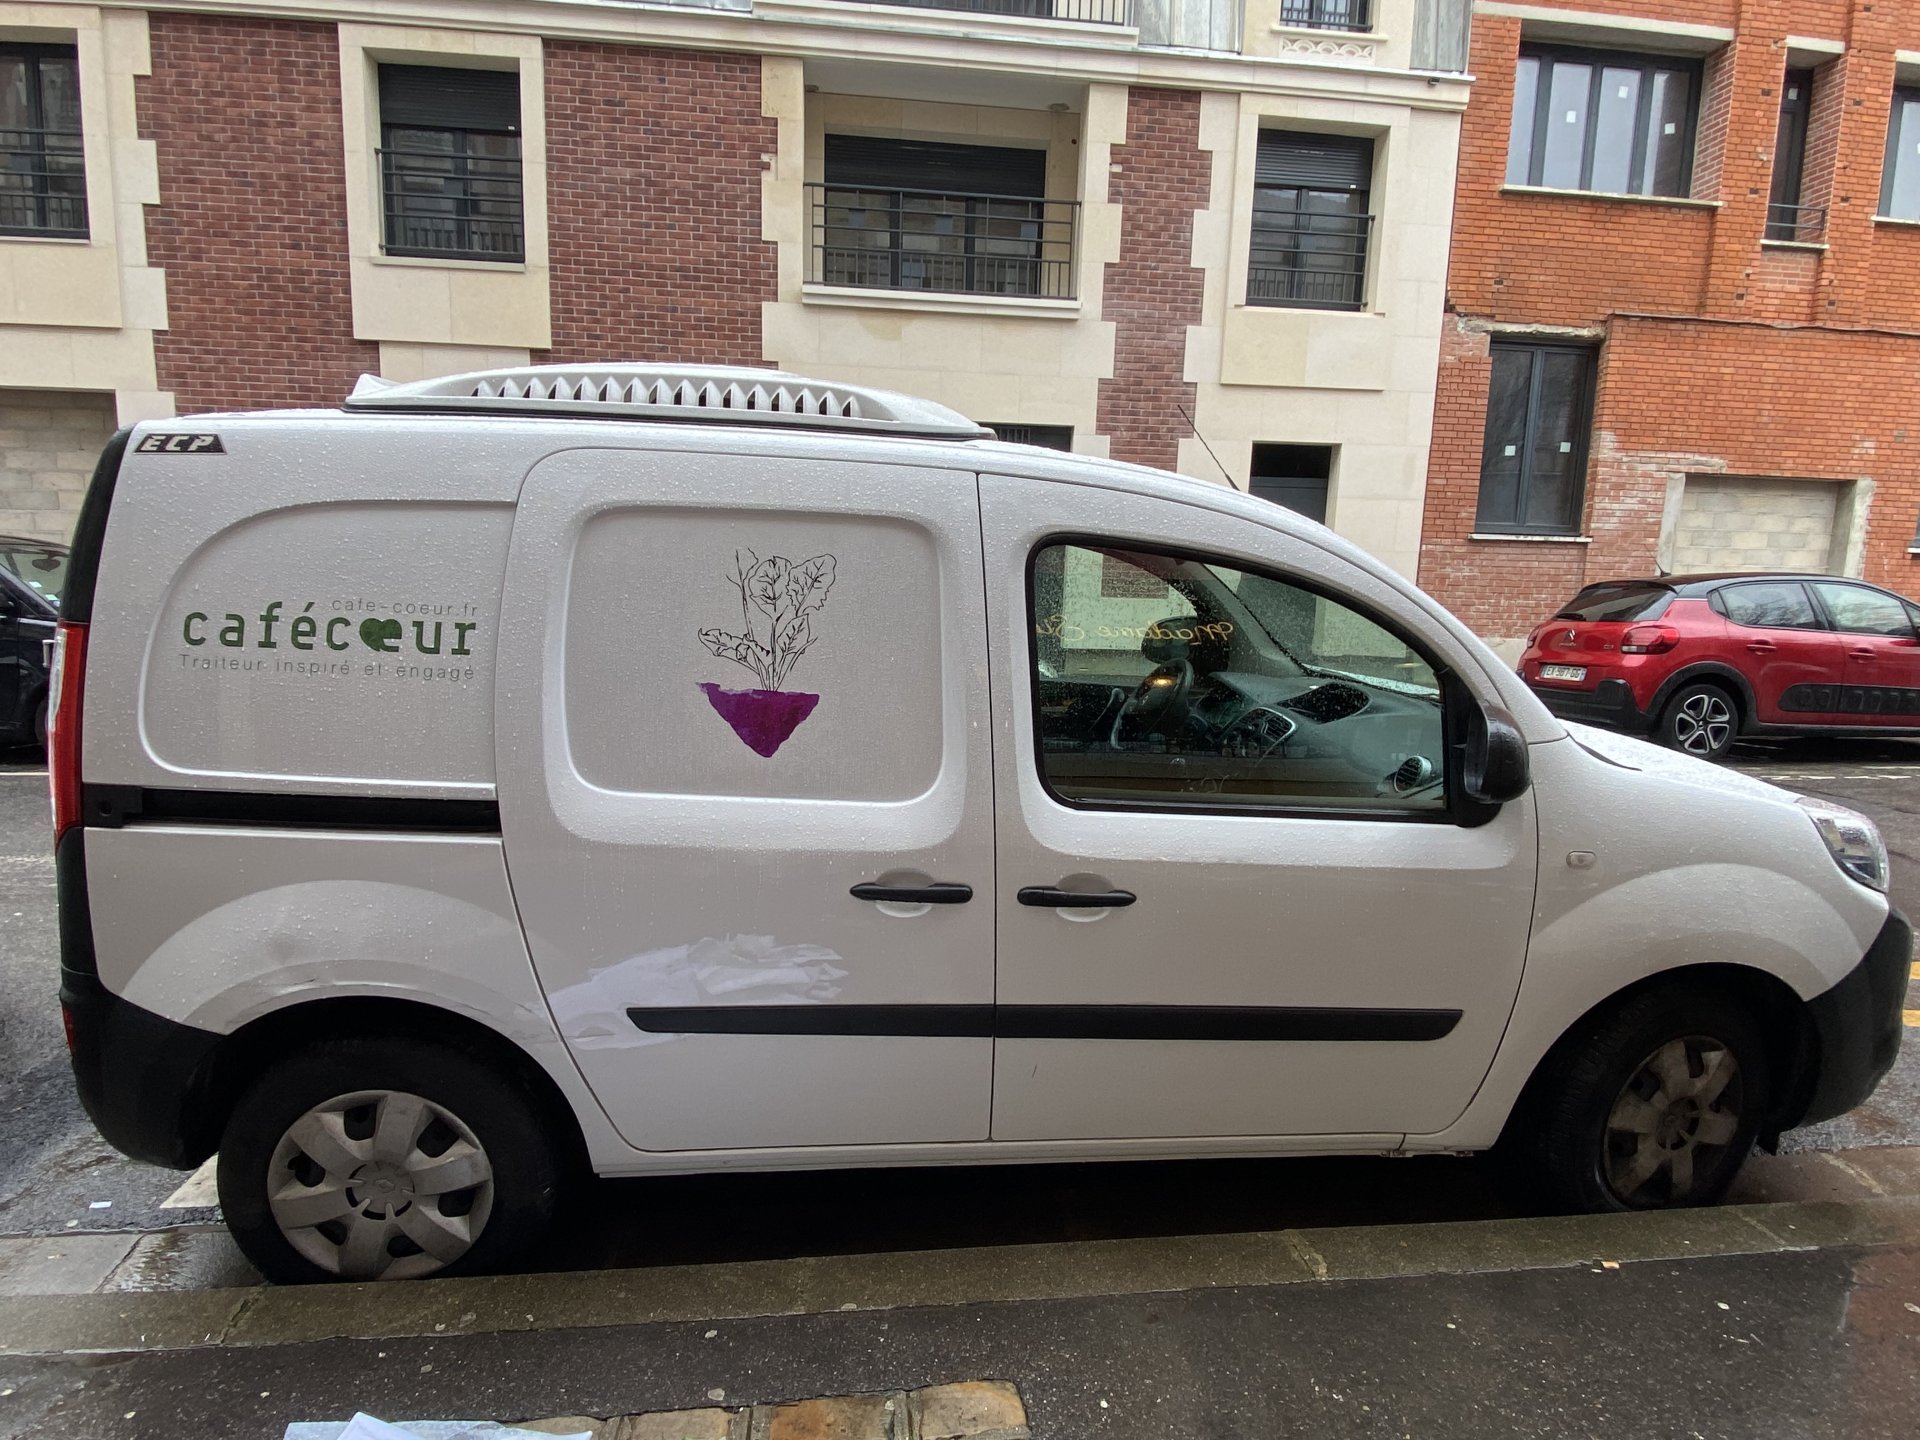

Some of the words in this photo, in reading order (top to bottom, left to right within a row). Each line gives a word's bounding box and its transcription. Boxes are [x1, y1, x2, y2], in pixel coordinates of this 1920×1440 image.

[140, 435, 215, 452] ECP
[178, 653, 263, 671] Traiteur
[276, 659, 350, 675] inspiré
[364, 664, 382, 676] et
[396, 665, 475, 682] engagé
